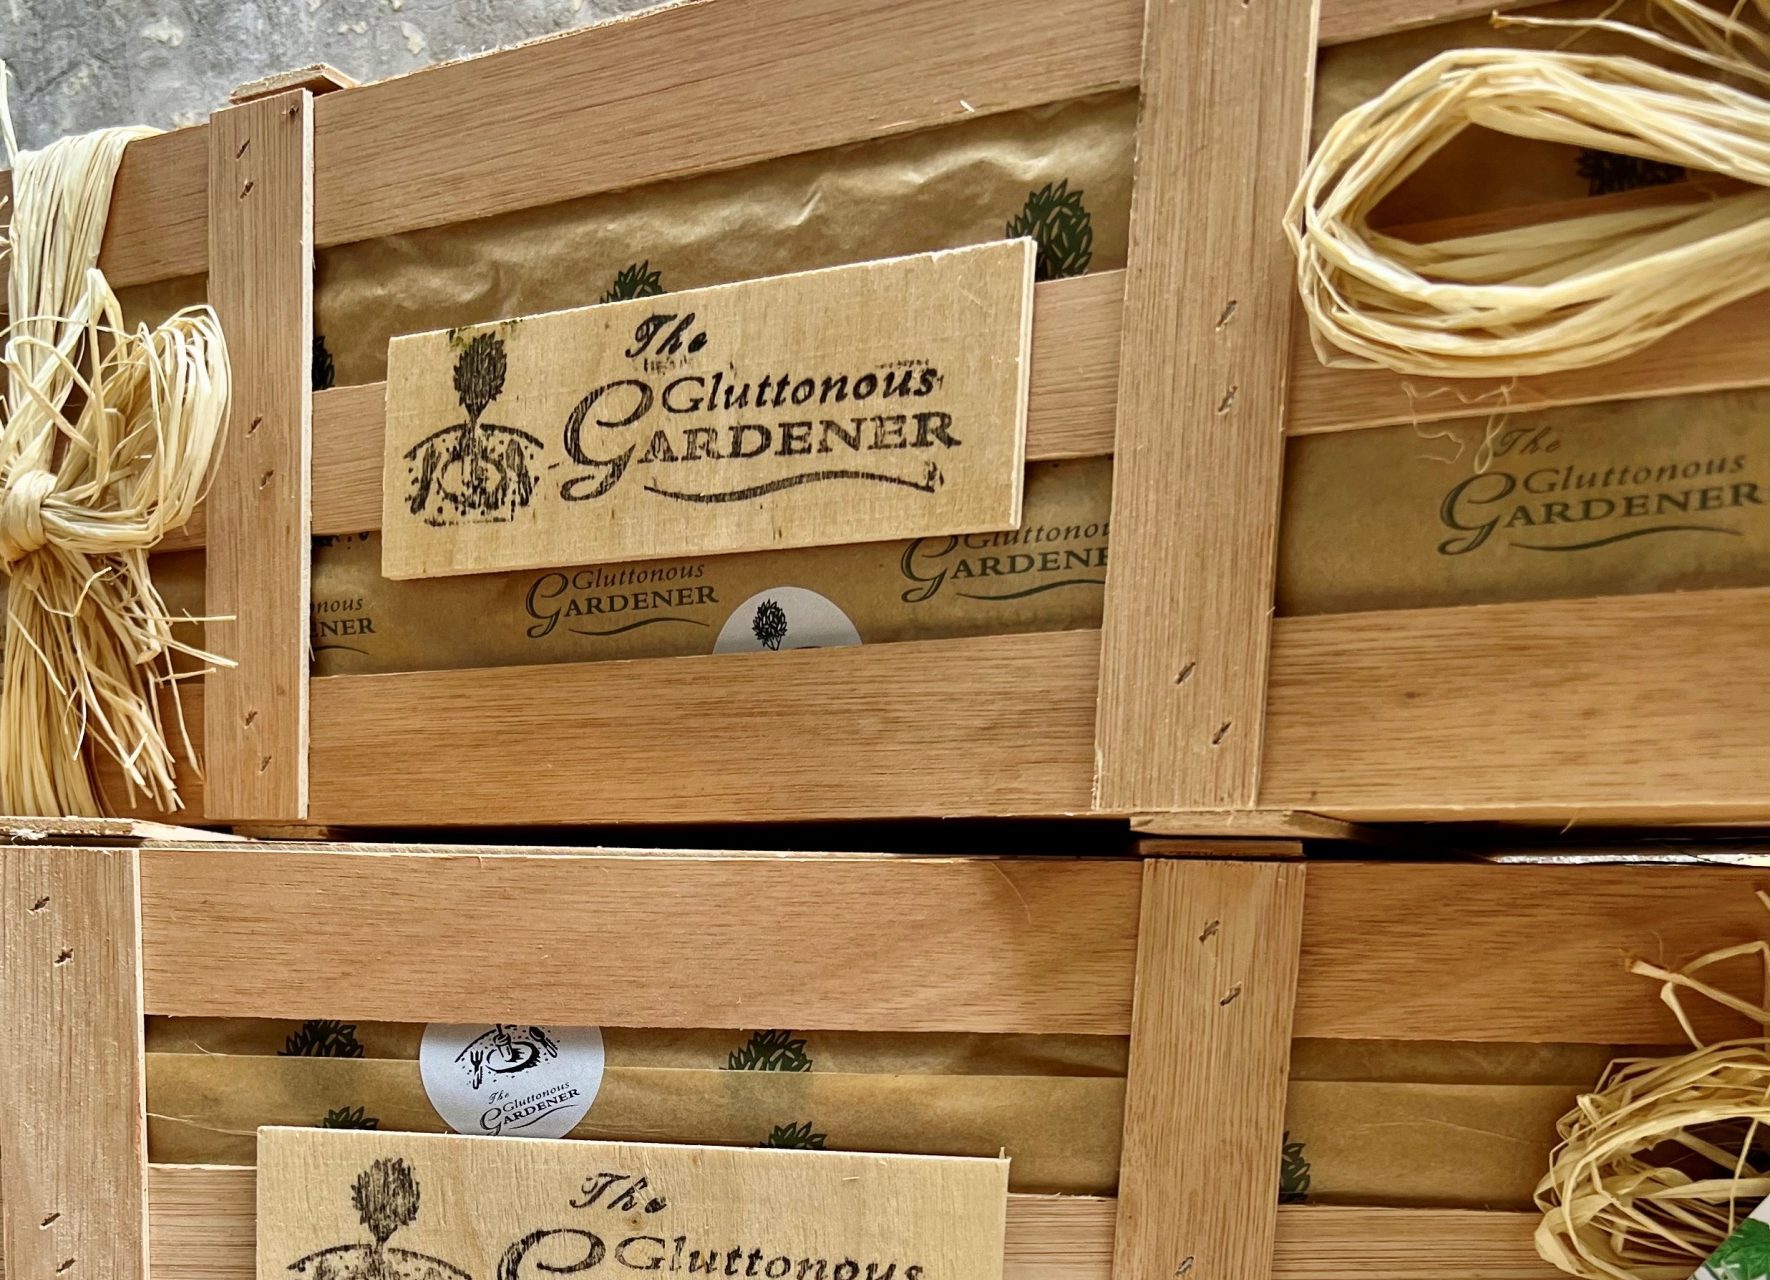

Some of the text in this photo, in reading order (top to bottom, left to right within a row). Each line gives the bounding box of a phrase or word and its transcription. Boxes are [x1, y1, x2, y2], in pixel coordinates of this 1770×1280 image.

[624, 312, 708, 358] The
[661, 367, 940, 415] Gluttonous
[559, 379, 962, 501] GARDENER
[1493, 425, 1562, 458] The
[1523, 455, 1746, 494] Gluttonous
[1437, 472, 1763, 556] GARDENER
[572, 563, 705, 590] Gluttonous
[525, 572, 719, 639] GARDENER
[480, 1088, 581, 1136] GARDENER
[488, 1089, 509, 1105] The
[502, 1081, 570, 1113] Gluttonous
[569, 1172, 667, 1213] The
